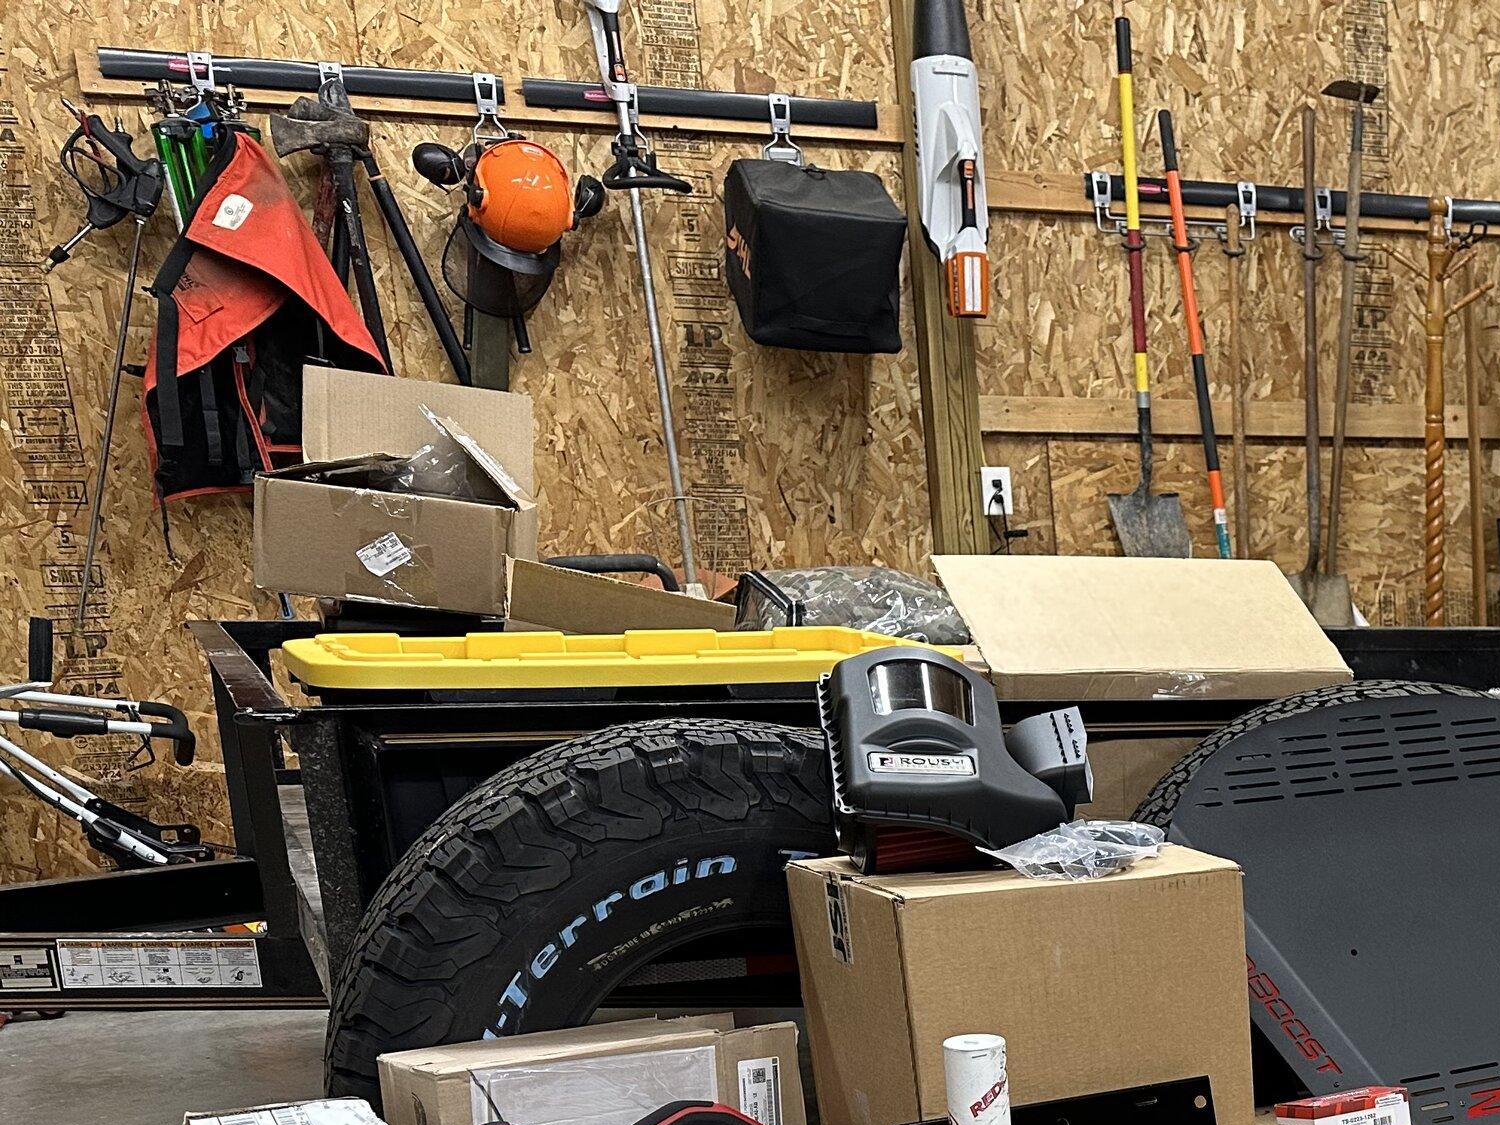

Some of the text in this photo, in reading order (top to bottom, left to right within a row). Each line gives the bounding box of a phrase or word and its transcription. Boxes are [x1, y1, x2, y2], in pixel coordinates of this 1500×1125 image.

[1356, 308, 1387, 330] LP
[684, 324, 723, 348] LP
[684, 370, 730, 385] APA
[482, 853, 738, 1041] -Terrain
